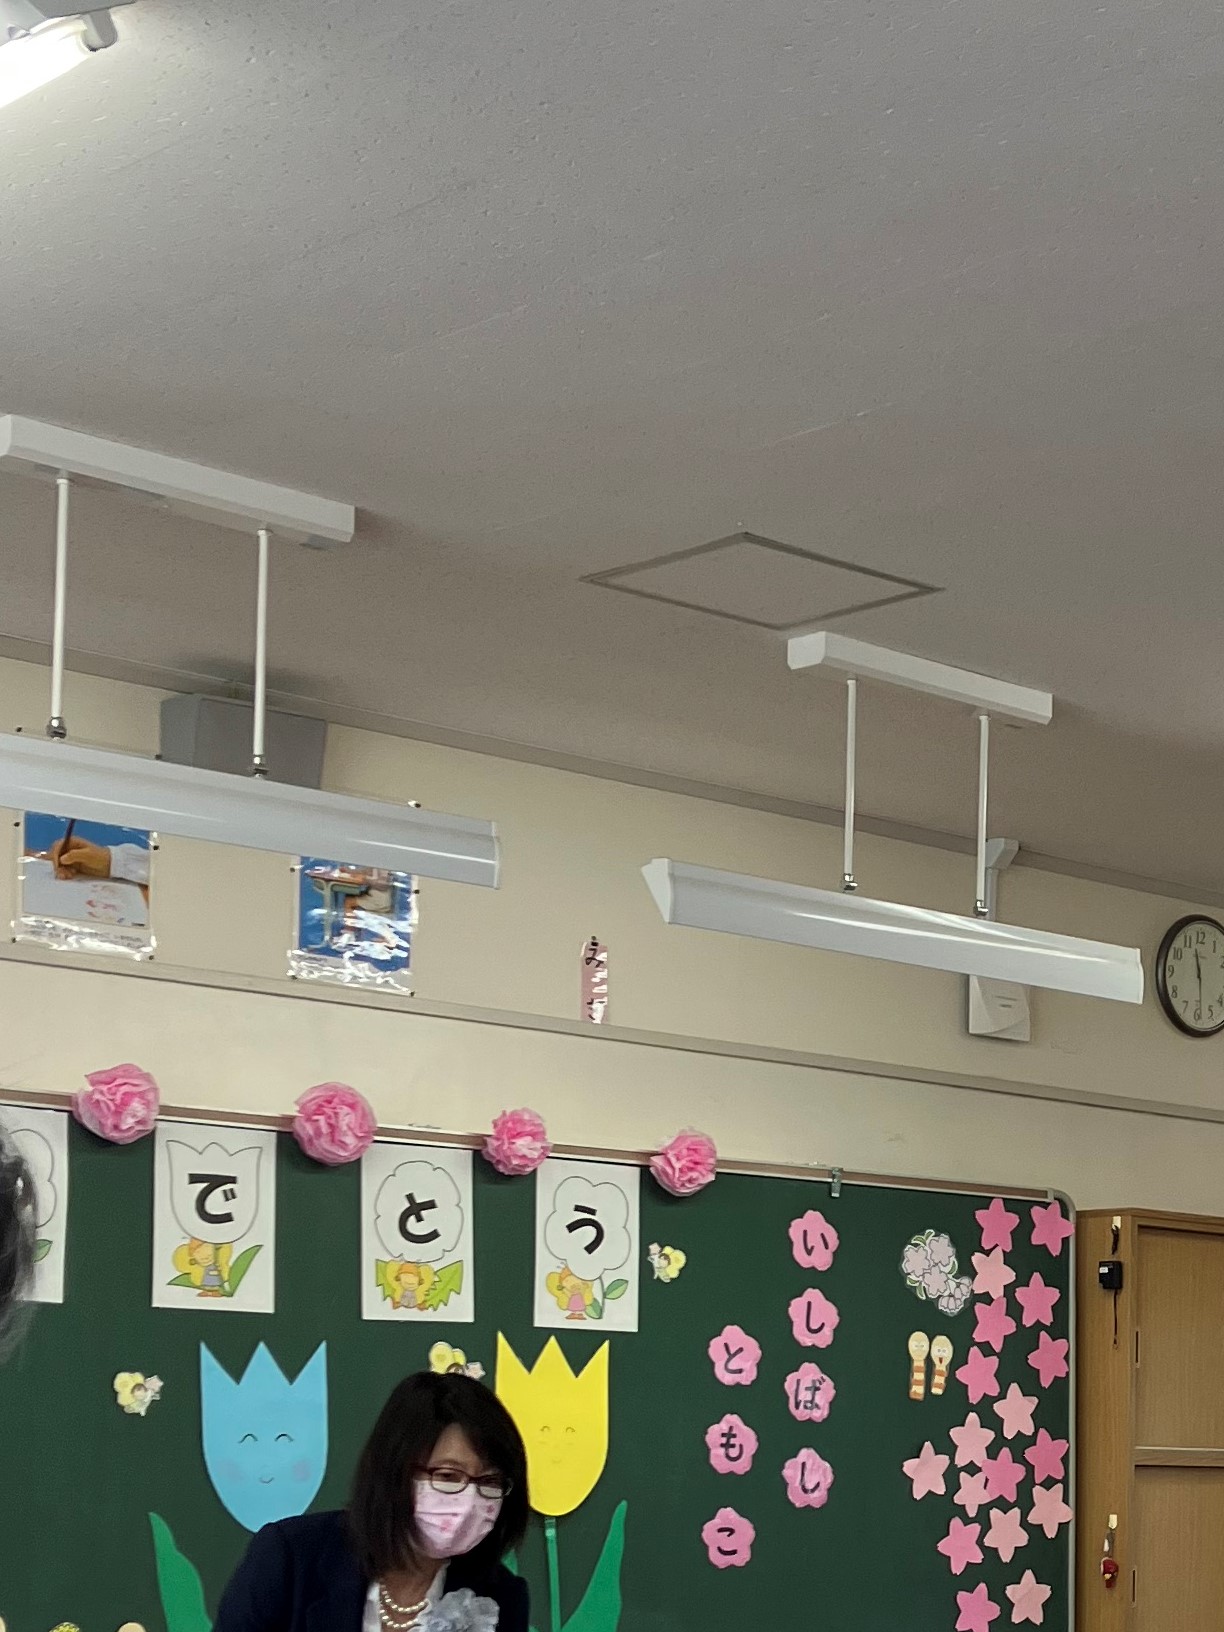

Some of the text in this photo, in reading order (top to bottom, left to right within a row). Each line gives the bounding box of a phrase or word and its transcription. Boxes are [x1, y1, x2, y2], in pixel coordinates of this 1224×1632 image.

[1184, 934, 1192, 948] 11
[1196, 931, 1206, 944] 12
[1173, 947, 1182, 960] 10
[1212, 941, 1216, 953] 1
[1168, 965, 1174, 978] 9
[1172, 985, 1178, 998] 8
[1182, 1001, 1188, 1014] 7
[1208, 1005, 1214, 1020] 5
[1194, 1008, 1201, 1021] 6
